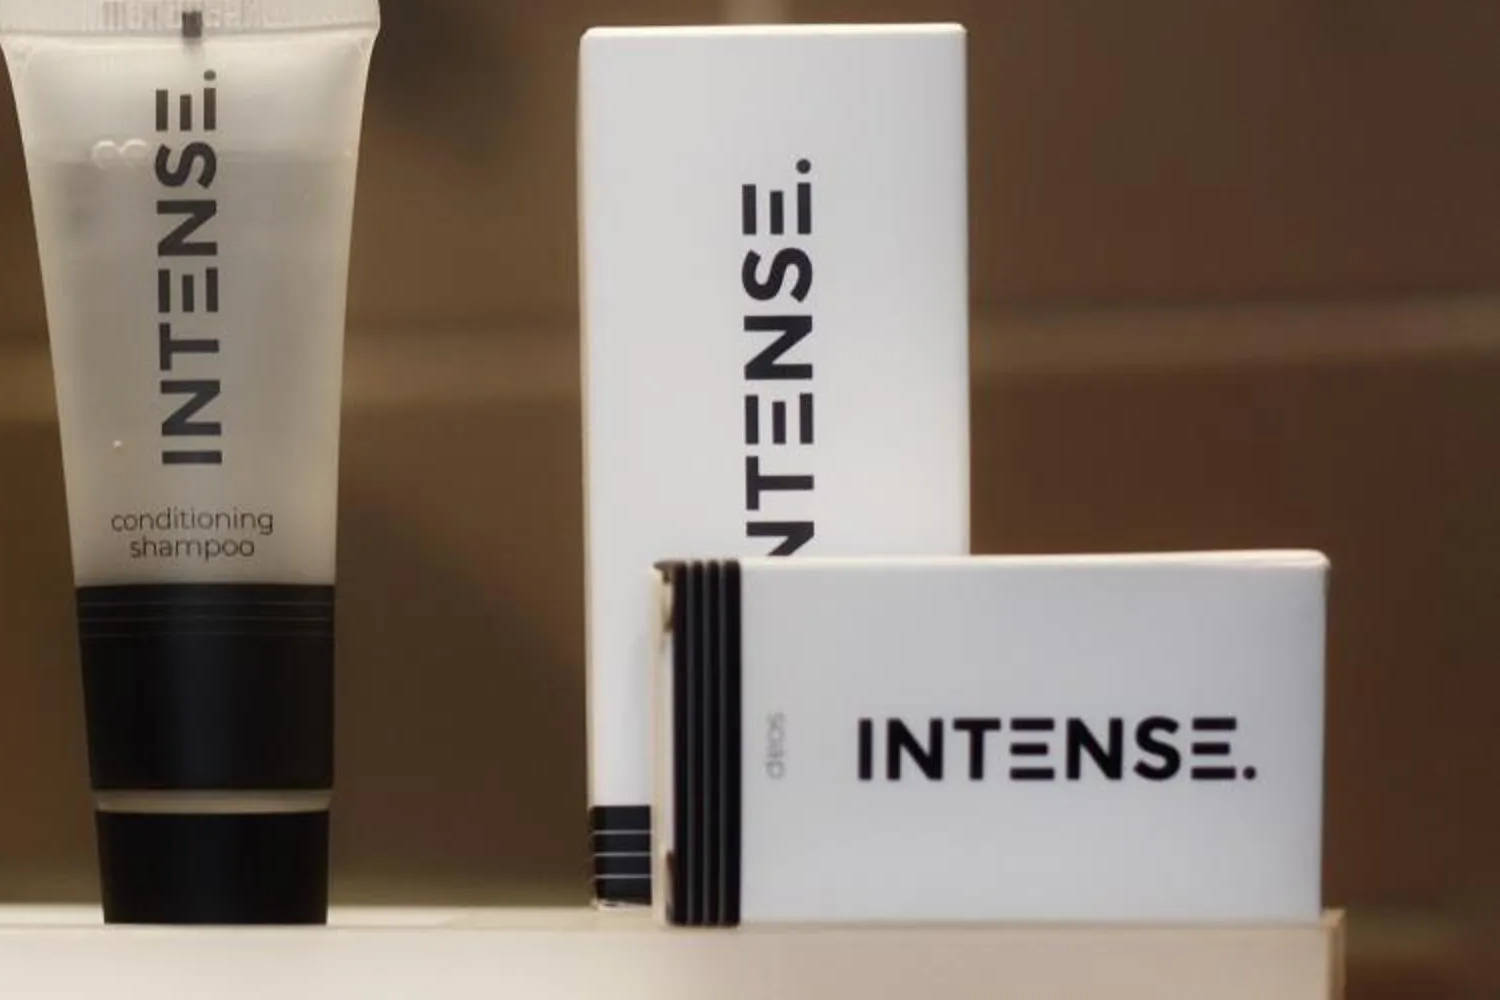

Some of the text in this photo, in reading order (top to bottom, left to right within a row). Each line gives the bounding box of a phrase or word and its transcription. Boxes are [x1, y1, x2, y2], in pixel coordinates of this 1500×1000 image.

[155, 70, 223, 465] INTENSE.
[742, 158, 815, 557] NTENSE.
[110, 507, 274, 536] conditioning
[130, 536, 255, 561] shampoo
[764, 711, 786, 780] soap
[858, 716, 1257, 782] INTENSE.
